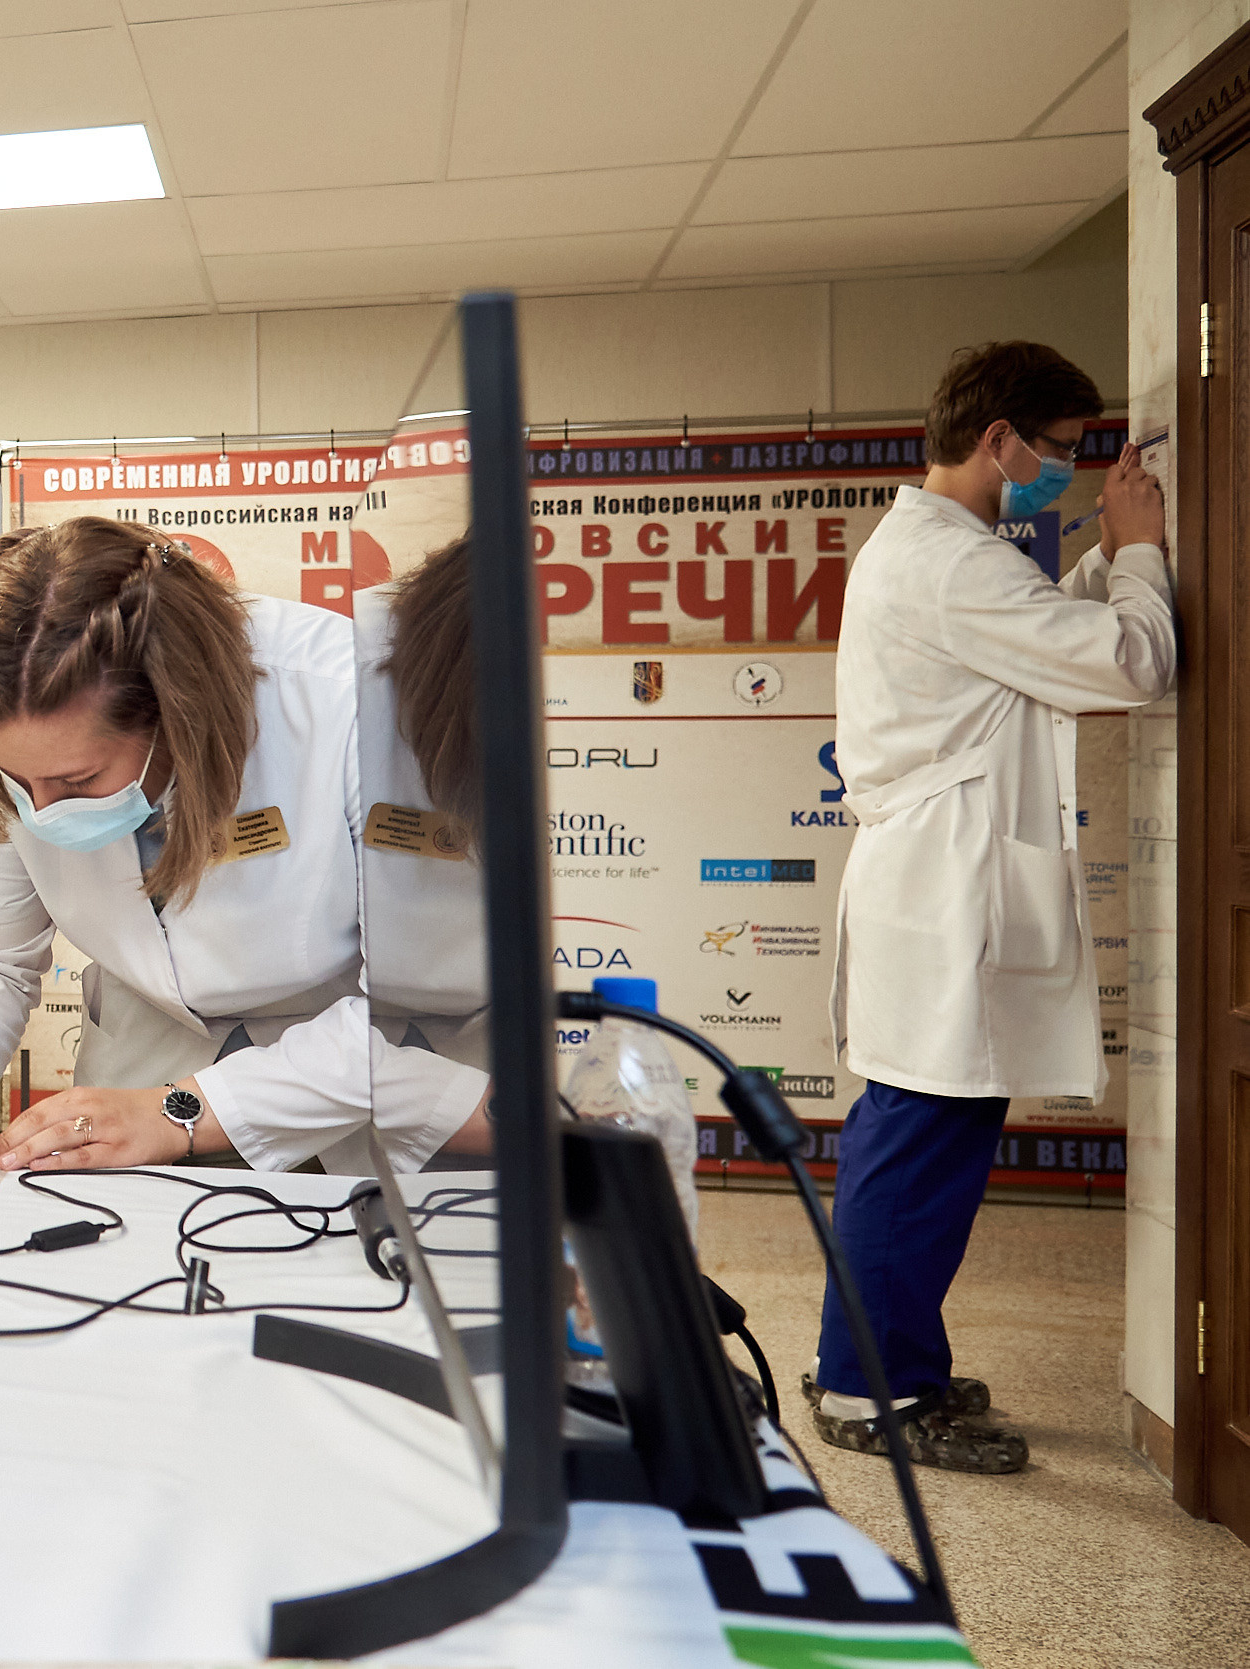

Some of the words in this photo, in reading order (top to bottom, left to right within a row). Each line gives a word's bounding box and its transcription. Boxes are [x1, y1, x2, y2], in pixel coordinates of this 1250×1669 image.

[44, 463, 231, 492] СОВРЕМЕННАЯ
[241, 458, 378, 486] УРОЛОГИЯ
[730, 439, 926, 469] ЛАЗЕРОФИКАЦ
[149, 504, 318, 527] Всероссийская
[329, 505, 359, 522] на
[593, 494, 761, 516] Конференция
[772, 486, 900, 510] «УРОЛОГИЧ
[995, 522, 1038, 539] АУЛ
[791, 811, 848, 827] KARL
[606, 867, 625, 879] for
[700, 1014, 782, 1025] VOLKMANN
[1036, 1139, 1126, 1170] ВЕКА
